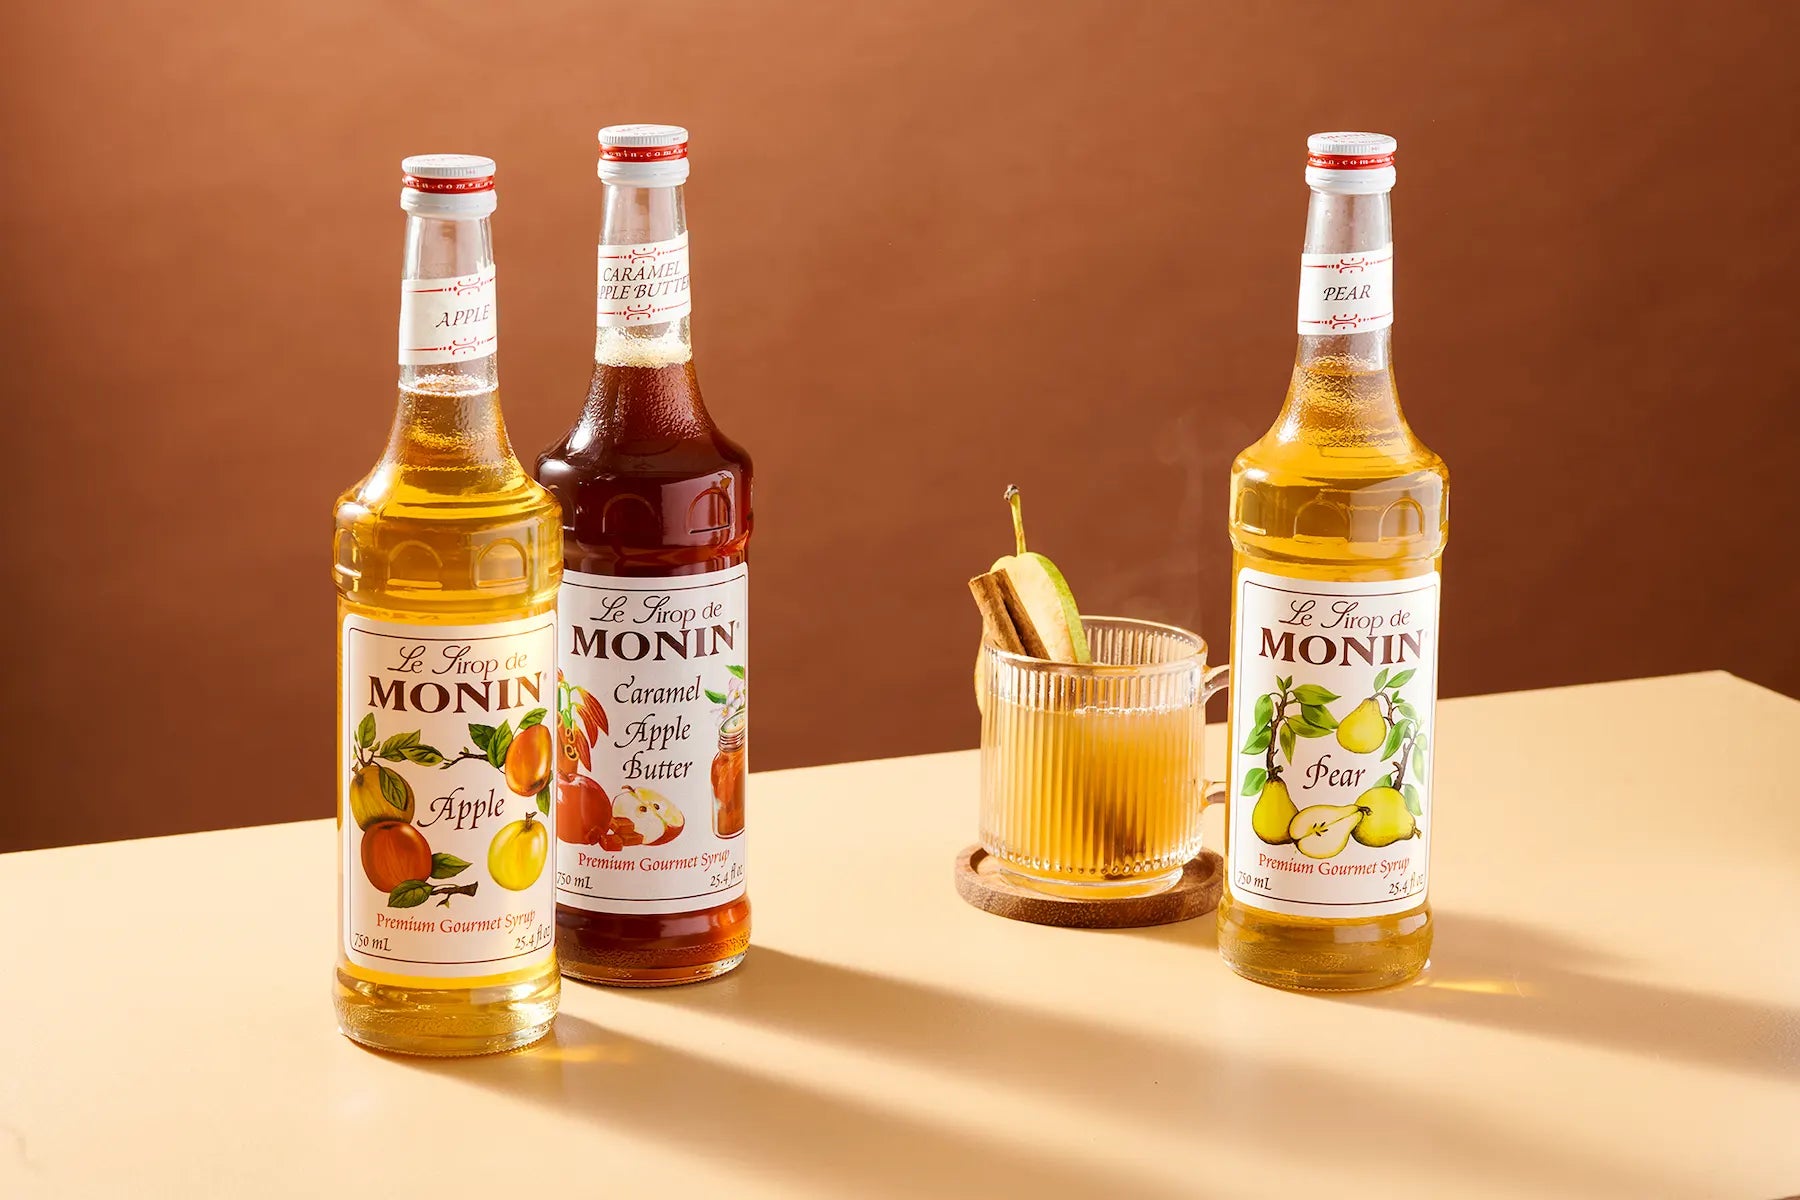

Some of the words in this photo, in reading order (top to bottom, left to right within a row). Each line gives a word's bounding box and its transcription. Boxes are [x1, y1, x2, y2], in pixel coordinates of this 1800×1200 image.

[603, 261, 680, 282] CARAMEL
[598, 285, 631, 300] PPLE
[634, 274, 690, 299] BUTTE
[1323, 284, 1371, 301] PEAR
[435, 304, 490, 328] APPLE
[589, 596, 628, 623] Le
[633, 595, 696, 630] Sirop
[702, 601, 723, 619] de
[1278, 600, 1316, 627] Le
[1321, 600, 1385, 635] Sirop
[1390, 609, 1411, 626] de
[571, 620, 736, 662] MONIN
[1258, 627, 1423, 667] MONIN
[387, 645, 426, 674] Le
[432, 645, 499, 681] Sirop
[505, 652, 528, 671] de
[368, 671, 542, 714] MONIN
[613, 675, 702, 704] Caramel
[614, 713, 692, 750] Apple
[622, 751, 693, 780] Butter
[1302, 754, 1366, 790] Pear
[417, 787, 505, 831] Apple
[578, 852, 635, 871] Premium
[639, 855, 698, 872] Gourmet
[701, 849, 730, 872] Syrup
[1259, 853, 1314, 874] Premium
[1318, 859, 1377, 876] Gourmet
[1379, 857, 1410, 879] Syrup
[557, 871, 571, 886] 750
[574, 875, 593, 890] mL
[710, 871, 729, 888] 25.4
[1237, 871, 1252, 885] 750
[1254, 876, 1272, 891] mL
[1389, 880, 1408, 896] 25.4
[376, 913, 436, 933] Premium
[439, 917, 501, 934] Gourmet
[505, 909, 536, 934] Syrup
[354, 933, 369, 947] 750
[372, 937, 393, 951] mL
[514, 935, 534, 951] 25.4
